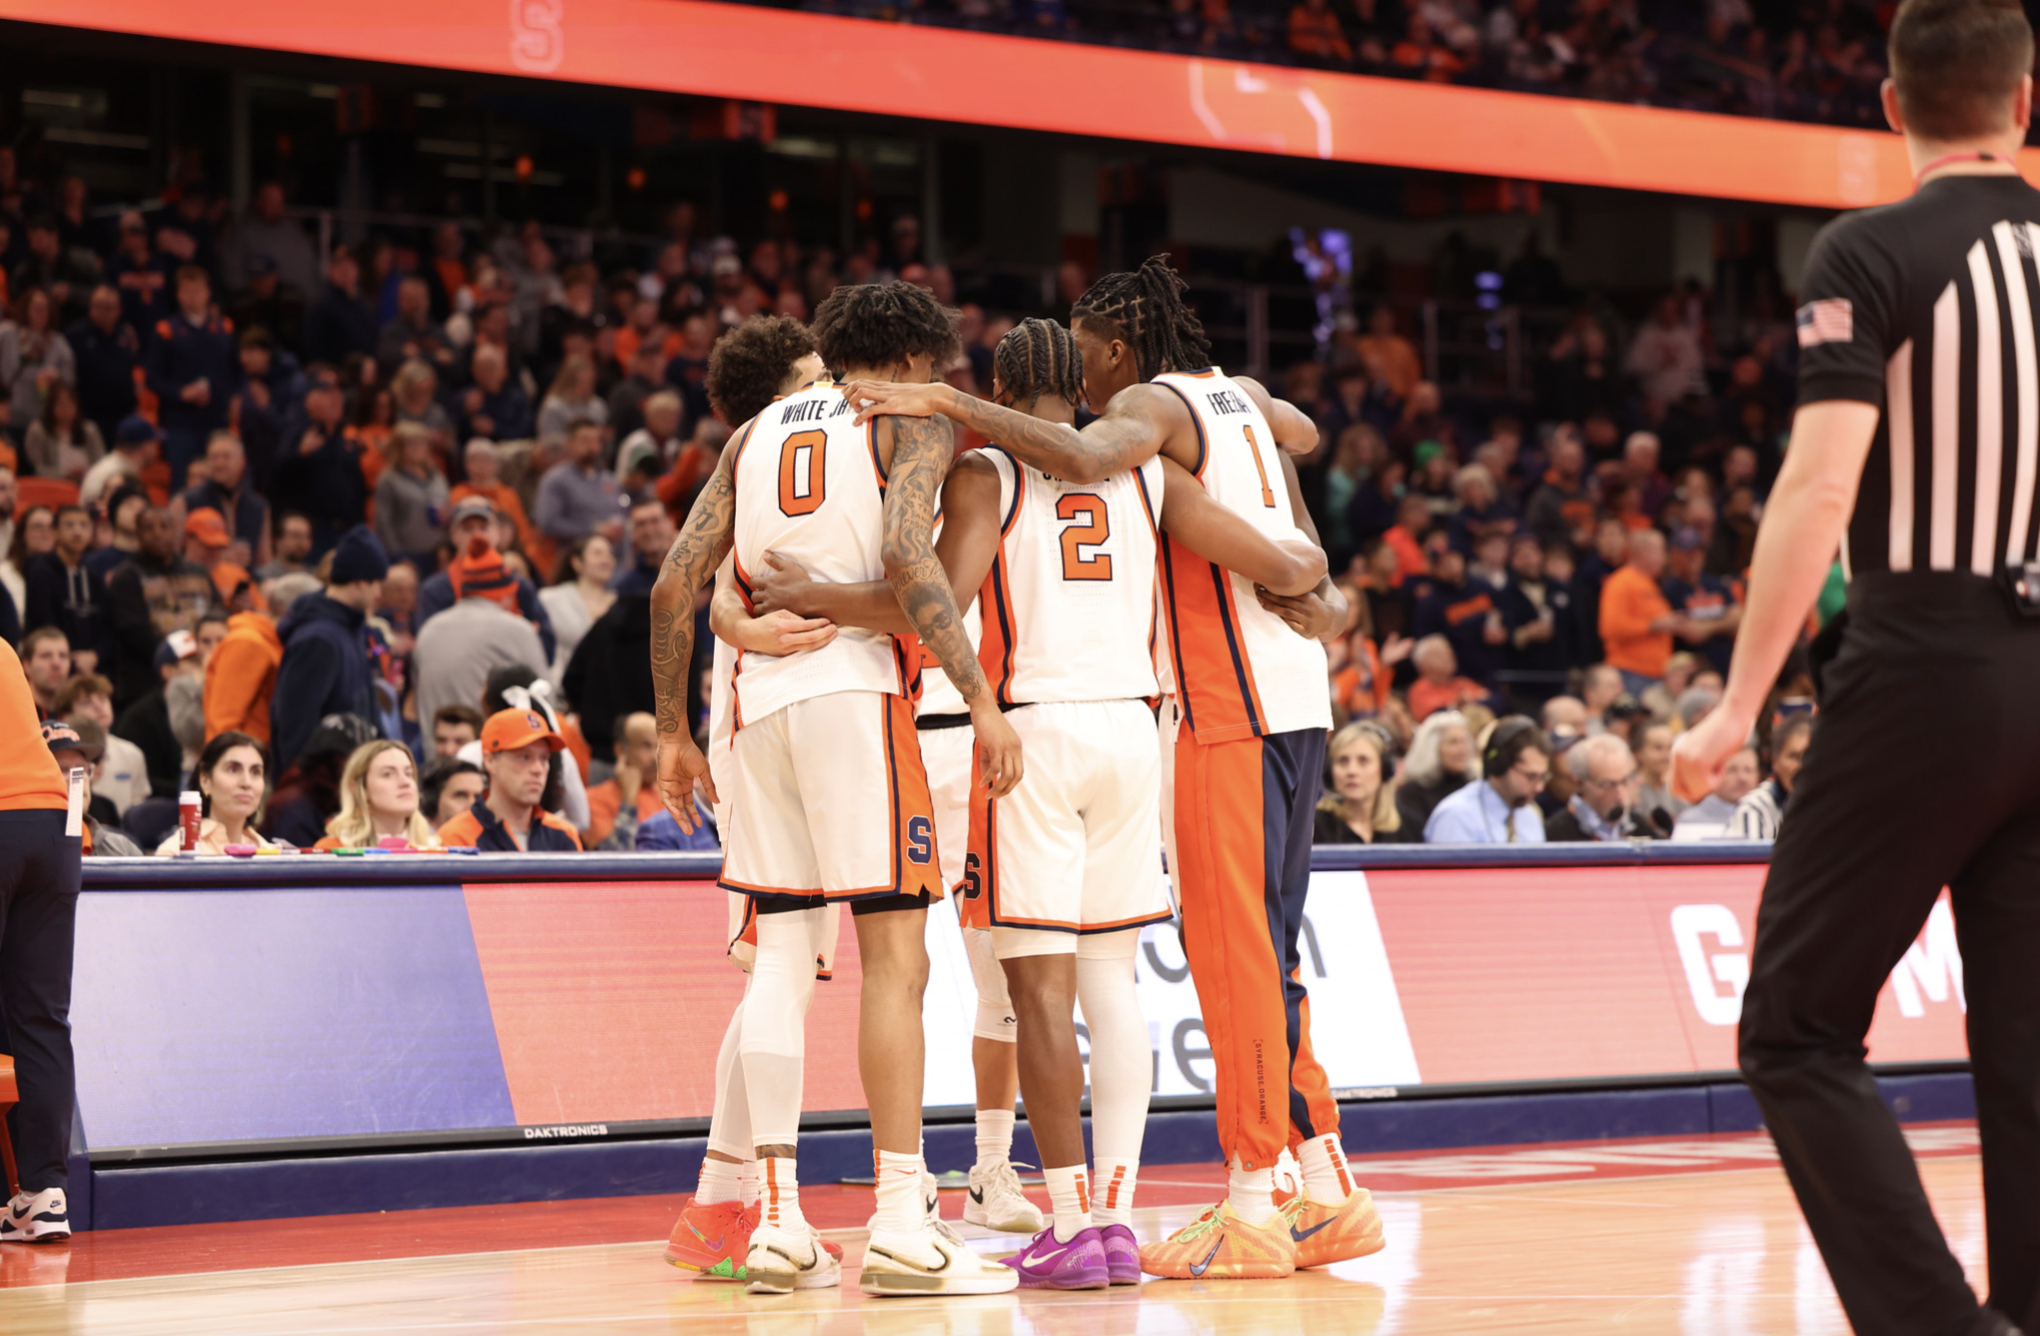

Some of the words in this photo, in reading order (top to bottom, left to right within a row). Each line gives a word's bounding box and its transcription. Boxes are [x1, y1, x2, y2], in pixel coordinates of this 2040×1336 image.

[781, 400, 828, 425] WHITE
[778, 428, 828, 518] 0
[1243, 424, 1276, 508] 1
[1055, 493, 1113, 581] 2
[907, 815, 932, 865] S
[963, 851, 982, 900] S
[523, 1124, 609, 1139] DAKTRONICS
